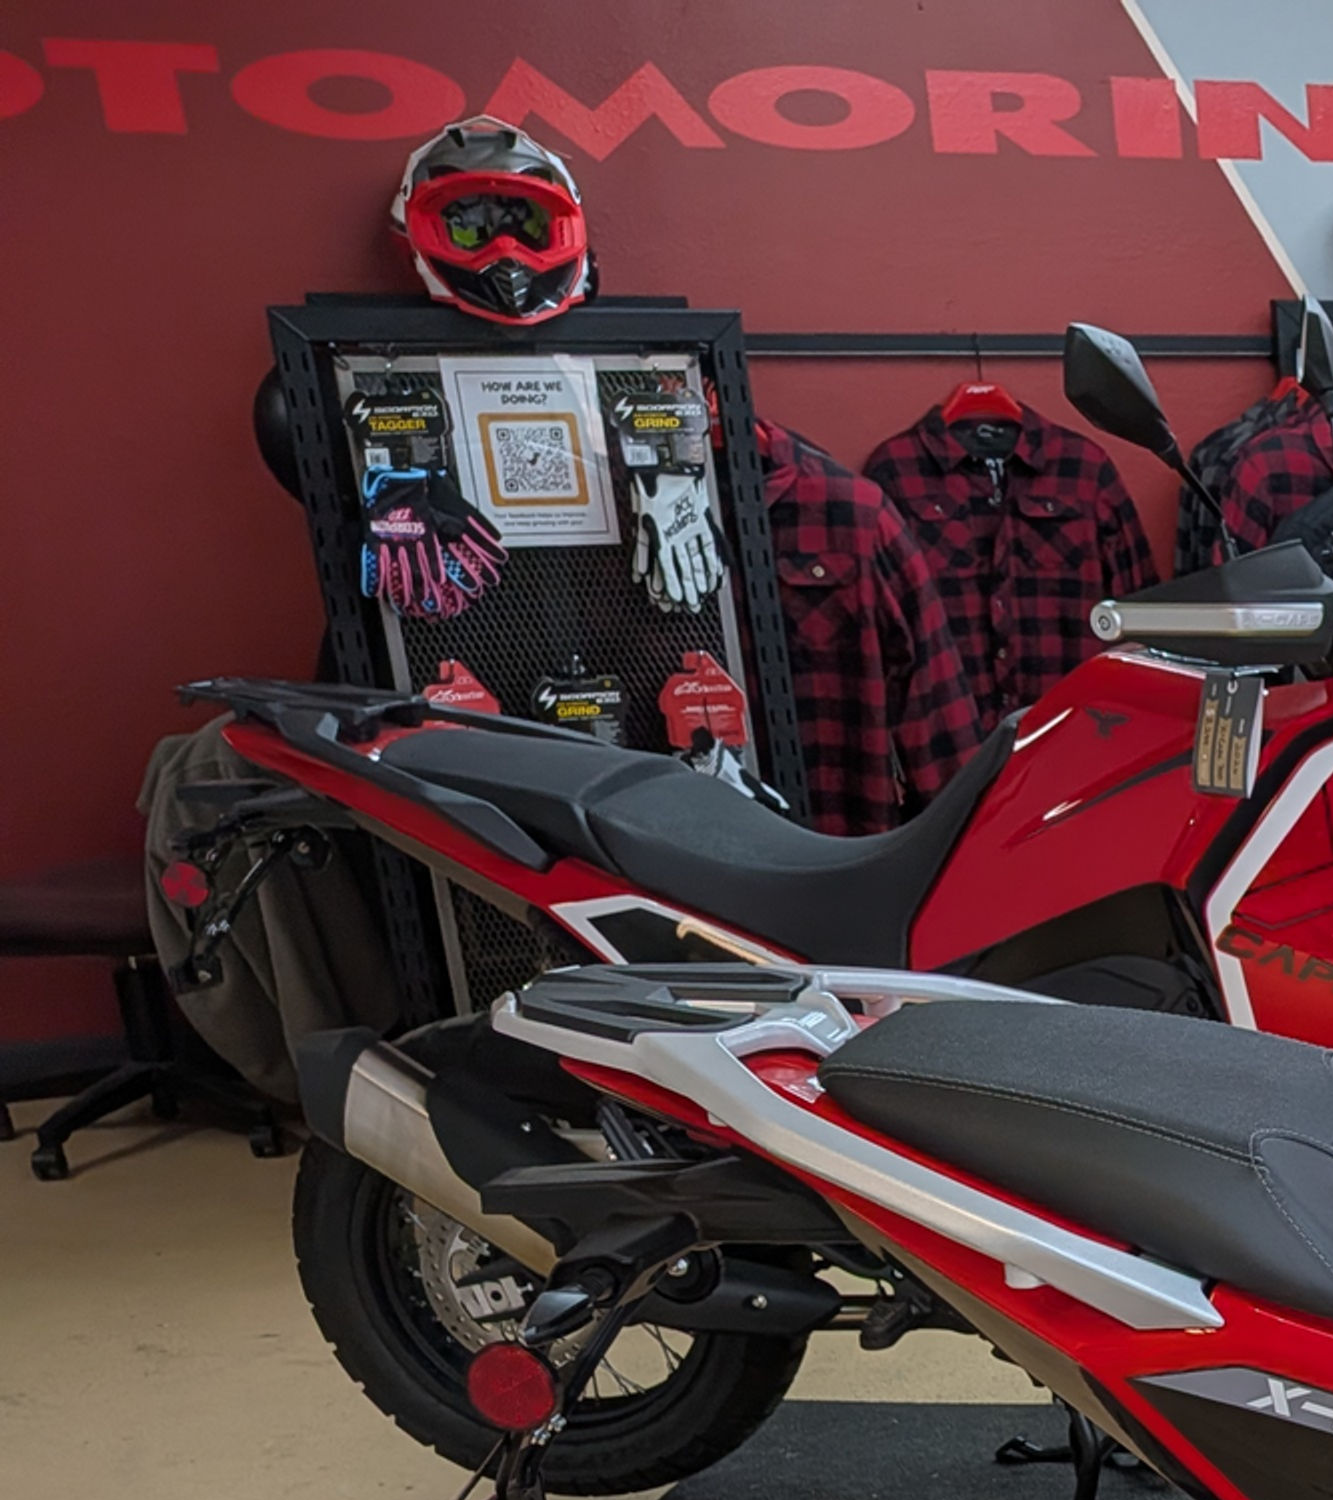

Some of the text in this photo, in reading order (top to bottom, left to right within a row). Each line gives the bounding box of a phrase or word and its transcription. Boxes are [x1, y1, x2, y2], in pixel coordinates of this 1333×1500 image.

[481, 381, 563, 393] HOW ARE WE
[501, 394, 548, 406] DOING?
[368, 419, 427, 431] TAGGER
[633, 416, 681, 428] GRIND
[556, 705, 602, 718] GRIND
